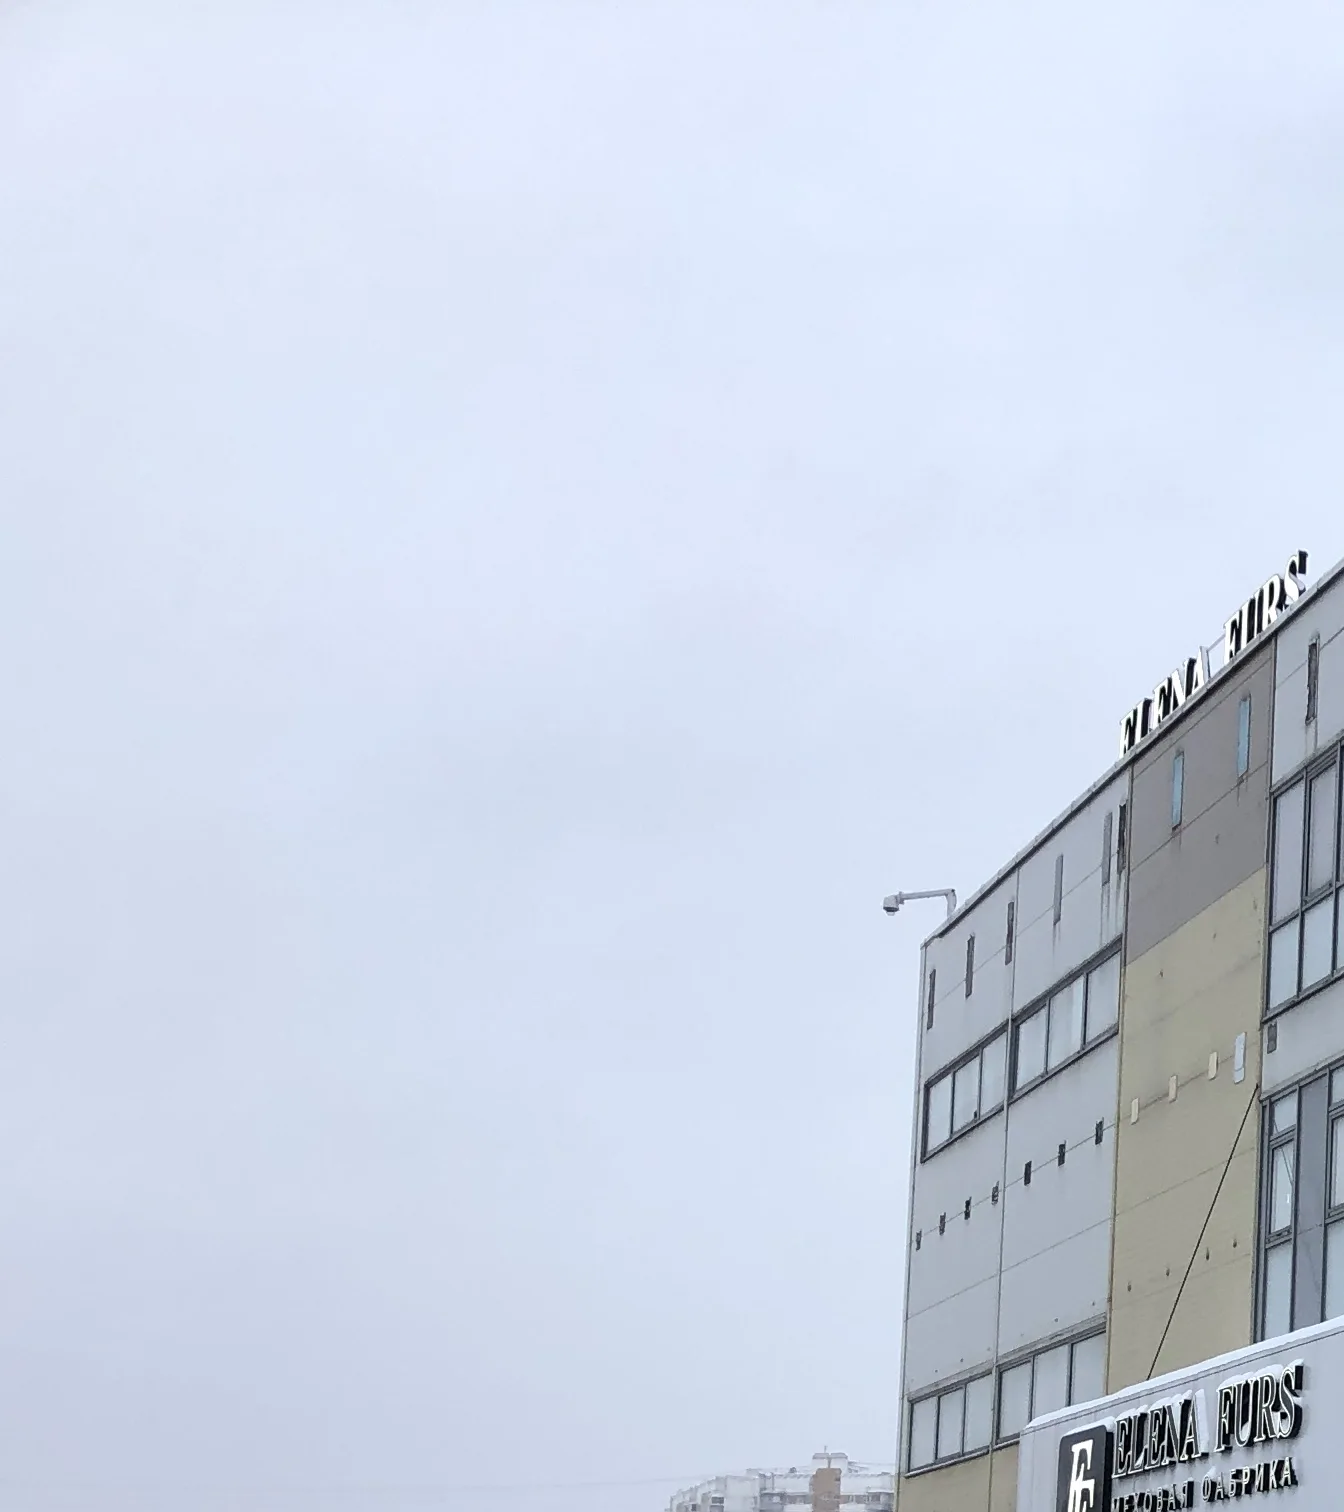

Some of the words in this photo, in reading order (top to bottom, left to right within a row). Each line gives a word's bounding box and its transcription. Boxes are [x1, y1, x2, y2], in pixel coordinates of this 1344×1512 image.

[1119, 646, 1207, 760] ELENA
[1223, 549, 1308, 666] FURS
[1112, 1392, 1208, 1479] ELENA
[1214, 1361, 1304, 1453] FURS
[1202, 1456, 1298, 1502] ФАБРИКА
